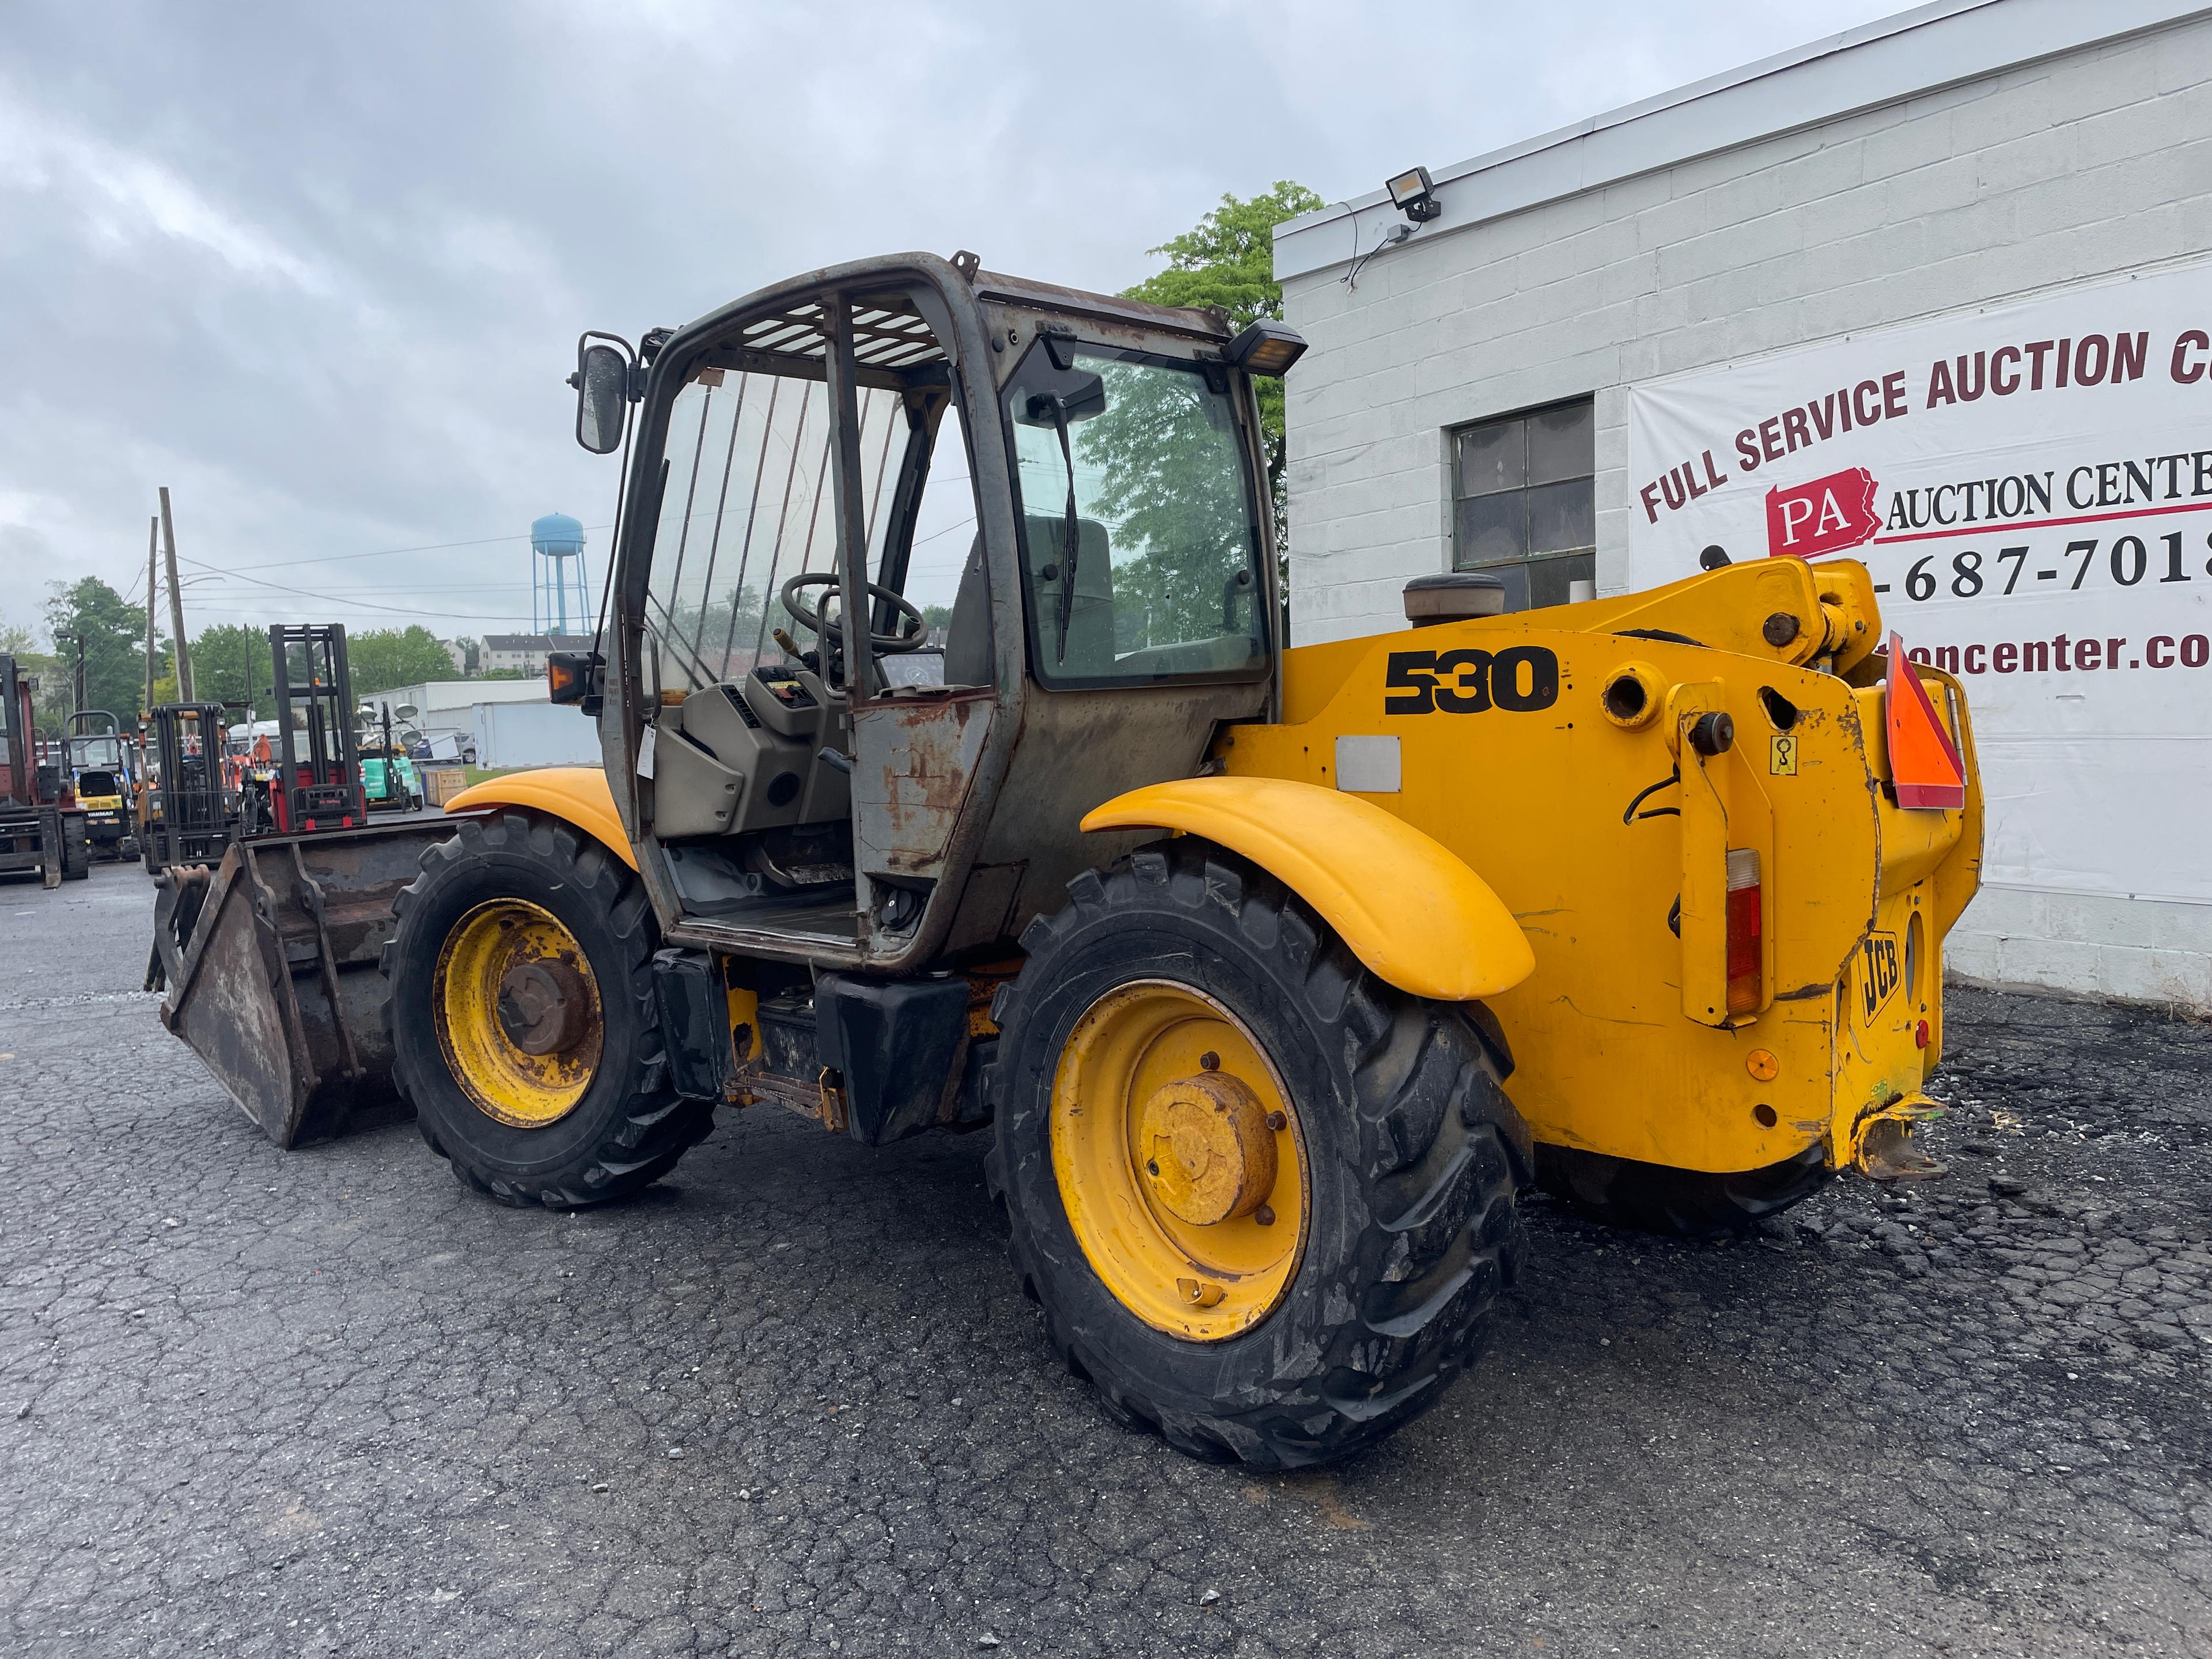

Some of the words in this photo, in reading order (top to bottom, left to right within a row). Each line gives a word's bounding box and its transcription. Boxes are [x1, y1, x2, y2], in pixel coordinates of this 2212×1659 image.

[1639, 449, 1728, 525] FULL
[1735, 370, 1908, 472] SERVICE
[1926, 331, 2149, 410] AUCTION
[2171, 329, 2212, 384] C
[1778, 487, 1852, 546] PA
[1886, 471, 2055, 531] AUCTION
[2066, 450, 2212, 510] CENTE
[1385, 645, 1559, 715] 530
[1864, 939, 1897, 1017] JCB
